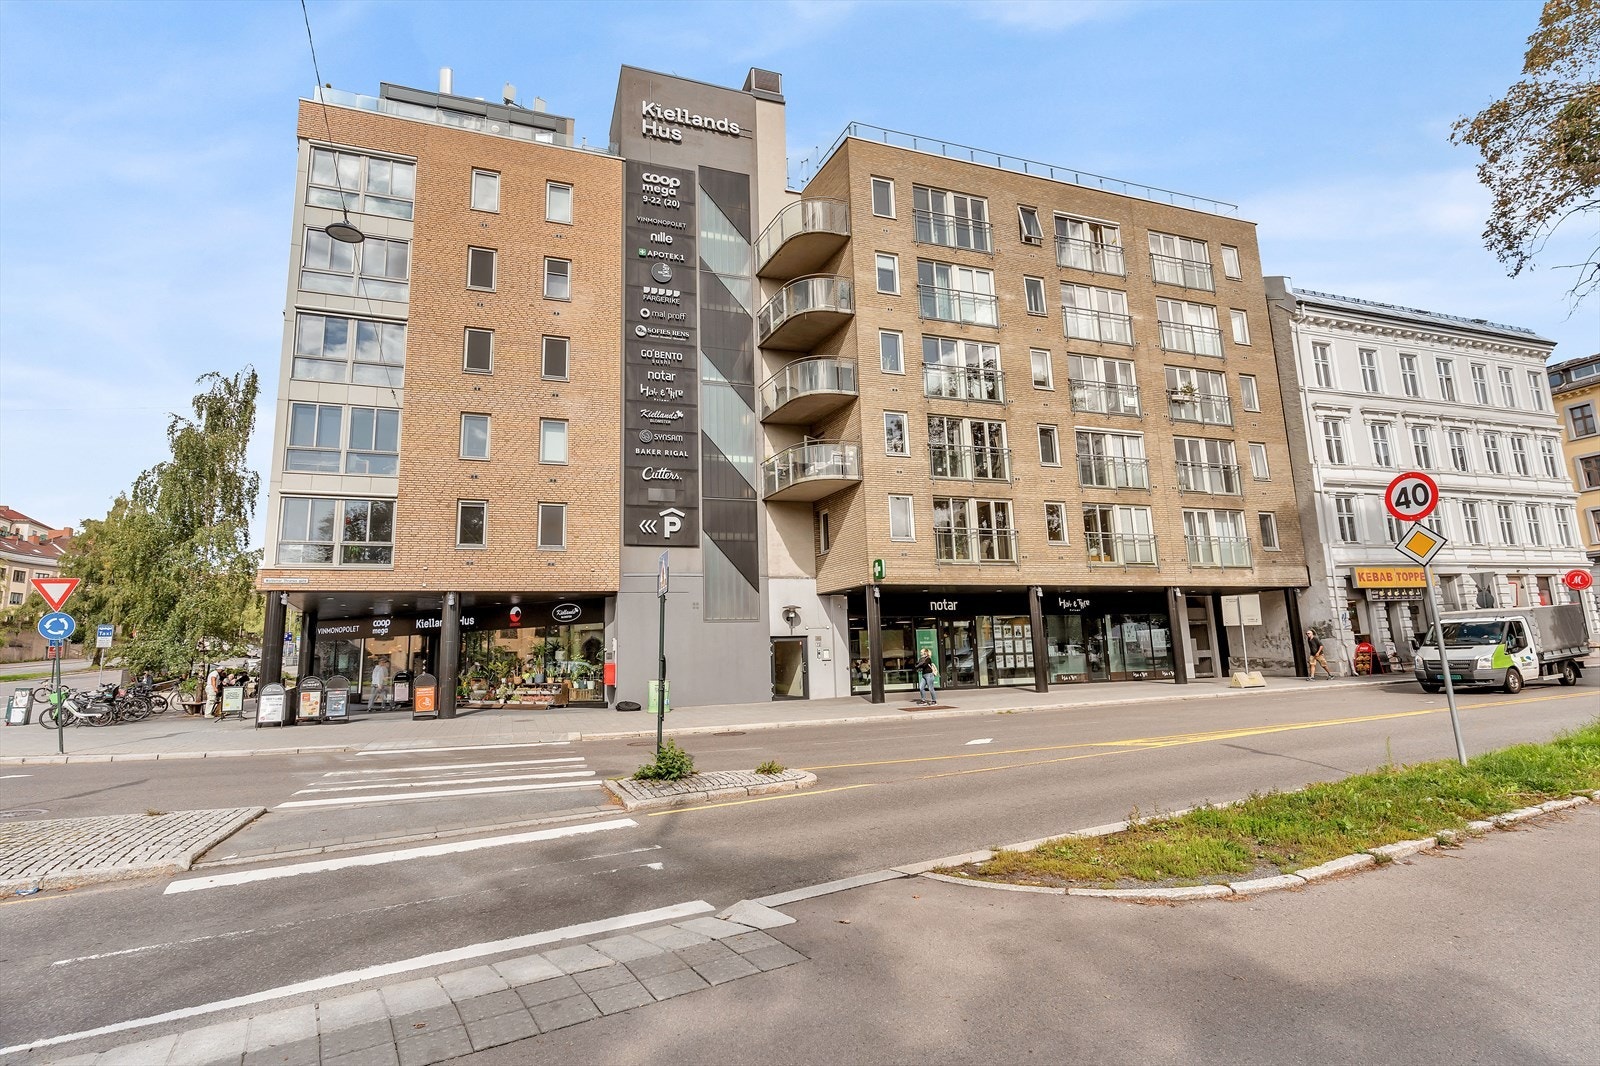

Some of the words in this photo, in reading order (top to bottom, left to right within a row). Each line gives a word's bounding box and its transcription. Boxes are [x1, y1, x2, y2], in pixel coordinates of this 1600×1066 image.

[642, 101, 740, 134] Kiellands
[642, 119, 682, 141] Hus
[642, 173, 680, 188] coop
[642, 184, 676, 197] mega
[642, 196, 661, 205] 9-22
[664, 199, 680, 209] (20)
[636, 216, 687, 229] VINMONOPOLET
[650, 232, 673, 245] nille
[647, 250, 679, 260] APOTEK
[643, 294, 680, 305] FARGERIKE
[667, 312, 687, 320] proff
[647, 327, 671, 335] SOFIES
[647, 370, 676, 381] notar
[640, 409, 680, 420] Kiellands
[1395, 482, 1430, 509] 40
[664, 516, 682, 538] P
[1358, 572, 1393, 582] KEBAB
[1395, 572, 1426, 581] TOPPE
[930, 599, 958, 611] notar
[372, 619, 391, 627] coop
[317, 625, 360, 635] VINMONOPOLET
[372, 627, 389, 636] mega
